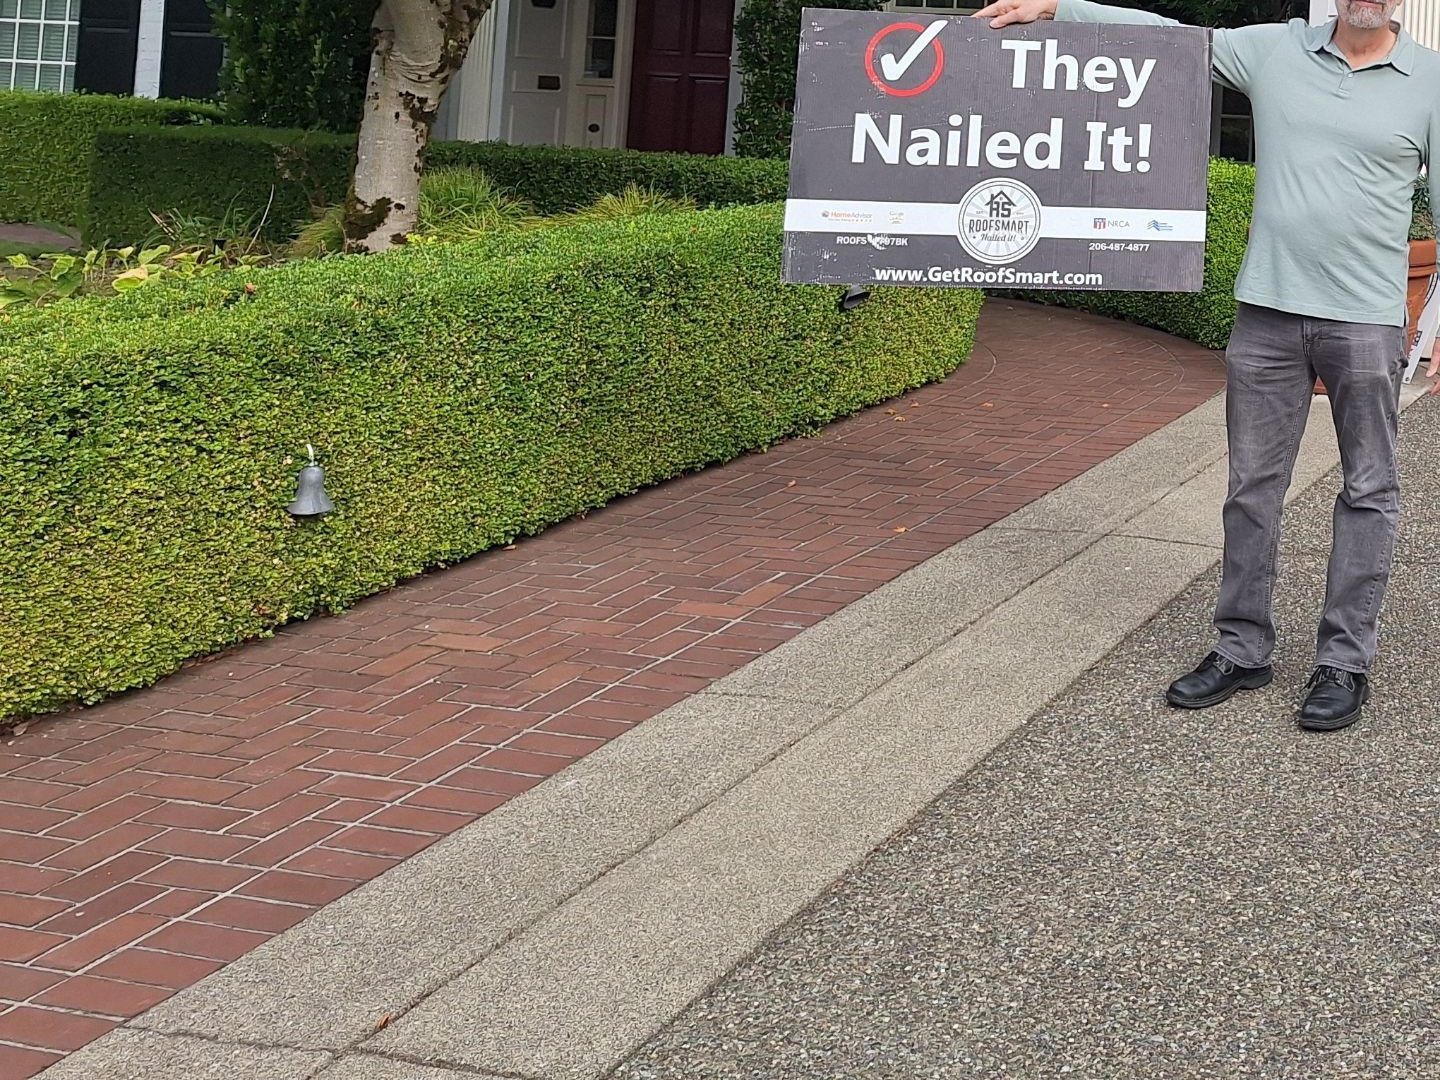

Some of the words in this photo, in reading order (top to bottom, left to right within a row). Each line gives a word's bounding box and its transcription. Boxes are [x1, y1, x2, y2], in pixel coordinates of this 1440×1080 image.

[1001, 38, 1157, 108] They
[851, 112, 1063, 170] Nailed
[1083, 121, 1152, 173] It!
[968, 219, 1030, 235] ROOFSMART
[1107, 220, 1130, 228] NRCA
[1088, 242, 1150, 252] 206-487-4877
[874, 266, 1103, 286] www.GetRoofSmart.com
